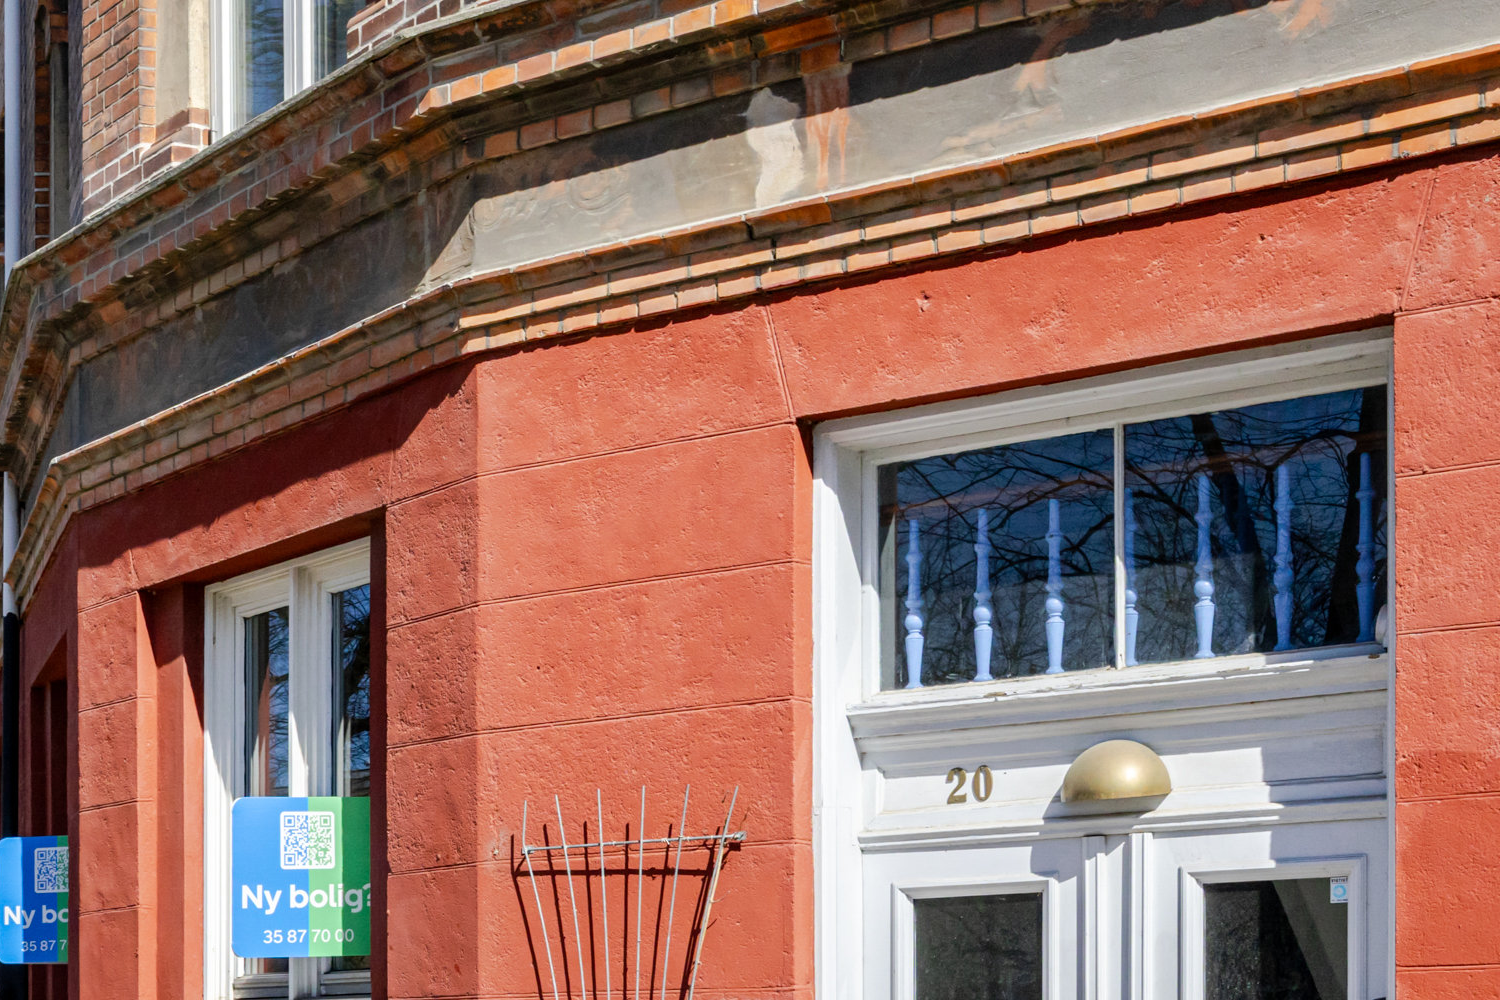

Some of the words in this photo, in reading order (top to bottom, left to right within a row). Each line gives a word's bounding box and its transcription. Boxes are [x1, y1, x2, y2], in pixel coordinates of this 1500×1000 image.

[945, 765, 993, 805] 20
[241, 884, 282, 915] Ny
[3, 905, 36, 929] Ny
[21, 940, 37, 952] 35
[40, 940, 56, 951] 87
[262, 929, 283, 944] 35
[286, 929, 307, 943] 87
[311, 929, 331, 943] 70
[334, 928, 355, 943] 00
